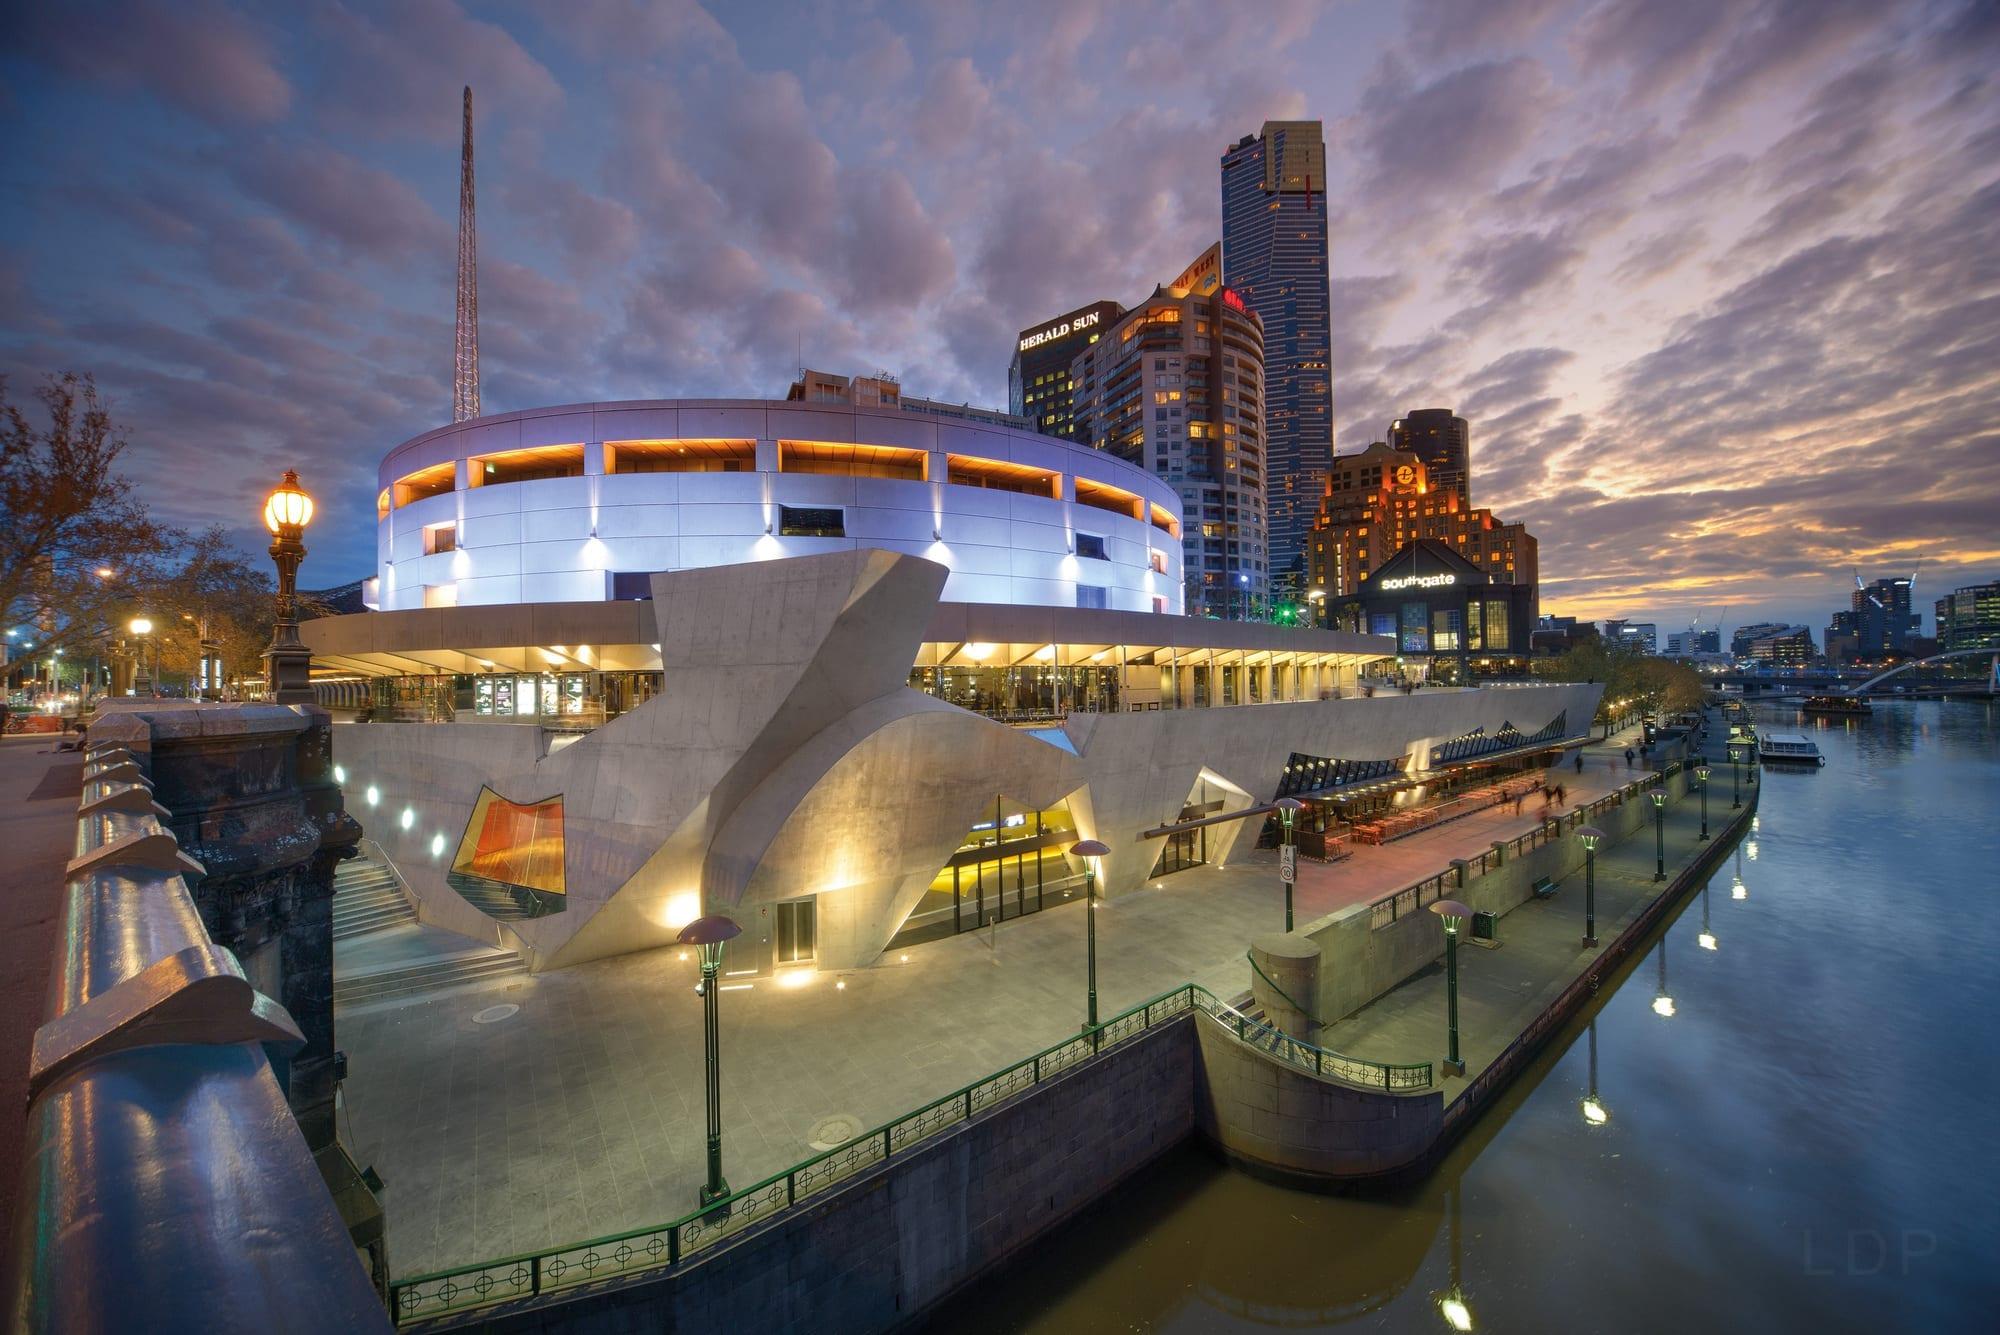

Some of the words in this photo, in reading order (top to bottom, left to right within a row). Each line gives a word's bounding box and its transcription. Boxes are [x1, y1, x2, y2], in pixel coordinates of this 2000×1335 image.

[1020, 323, 1070, 351] HERALD
[1073, 311, 1099, 331] SUN
[1381, 573, 1455, 590] southgate
